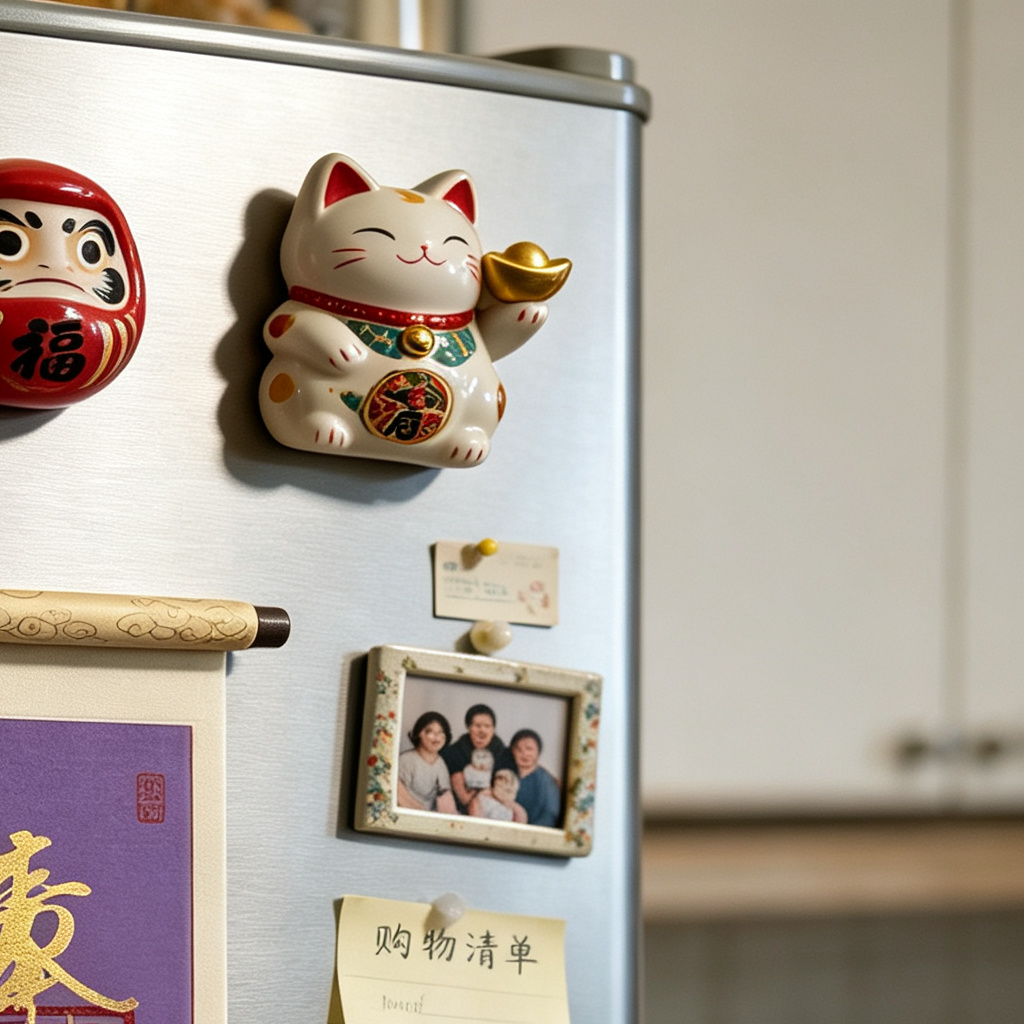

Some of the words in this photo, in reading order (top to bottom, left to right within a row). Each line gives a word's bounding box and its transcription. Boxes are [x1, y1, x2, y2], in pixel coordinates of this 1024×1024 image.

[10, 317, 86, 382] 福
[375, 923, 538, 975] 购物清单
